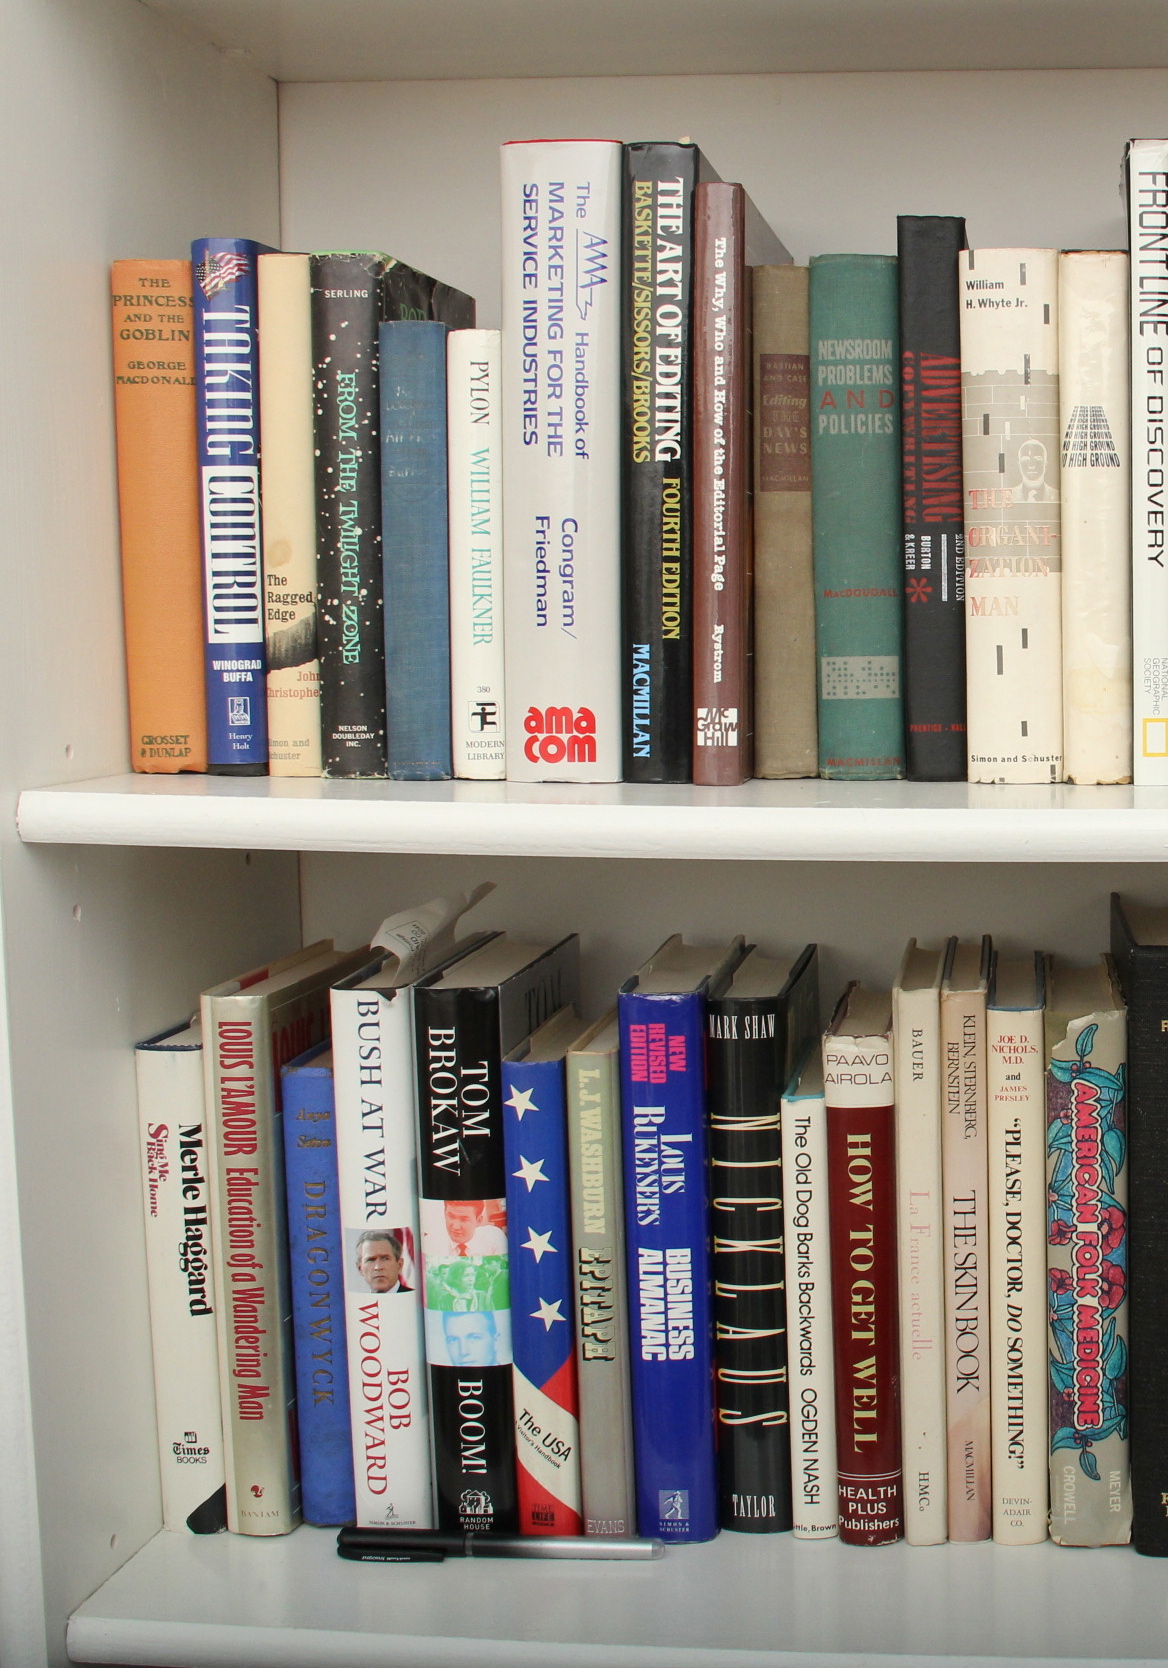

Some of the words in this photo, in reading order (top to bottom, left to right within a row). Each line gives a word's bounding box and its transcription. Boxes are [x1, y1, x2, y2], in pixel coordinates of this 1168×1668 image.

[523, 183, 539, 289] SERVICE
[657, 177, 685, 236] THE
[657, 239, 682, 300] ART
[1138, 171, 1168, 336] FRONTLINE
[139, 278, 171, 289] THE
[325, 290, 368, 298] SERLING
[966, 280, 1004, 290] William
[966, 299, 976, 309] H.
[978, 298, 1012, 309] Whyte
[1015, 298, 1028, 308] Jr.
[120, 328, 191, 342] GOBLIN
[125, 314, 152, 324] AND
[158, 314, 185, 324] THE
[656, 304, 682, 350] OF
[523, 299, 539, 446] INDUSTRIES
[818, 340, 892, 358] NEWSROOM
[818, 365, 892, 385] PROBLEMS
[1147, 348, 1163, 385] OF
[338, 371, 357, 441] FROM
[470, 361, 488, 425] PYLON
[655, 356, 682, 462] EDITING
[818, 414, 893, 434] POLICIES
[338, 447, 357, 493] THE
[470, 447, 493, 535] WILLIAM
[1146, 395, 1164, 568] DISCOVERY
[338, 495, 360, 596] TWILIGHT
[536, 516, 550, 628] Friedman
[267, 575, 287, 586] The
[267, 591, 313, 606] Ragged
[471, 548, 493, 646] FAULKNER
[560, 517, 578, 639] Congram/
[267, 609, 295, 622] Edge
[343, 604, 360, 664] ZONE
[213, 661, 262, 671] WINOGRAD
[223, 673, 253, 682] BUFFA
[713, 625, 724, 683] Rystrom
[218, 1022, 254, 1070] LOUIS
[357, 999, 382, 1088] BUSH
[710, 1014, 738, 1039] MARK
[745, 1014, 776, 1038] SHAW
[912, 1028, 923, 1081] BAUER
[824, 1072, 892, 1084] AIROLA
[827, 1054, 888, 1066] PAAVO
[220, 1076, 257, 1156] L'AMOUR
[360, 1098, 384, 1138] AT
[429, 1026, 461, 1176] BROKAW
[461, 1061, 490, 1138] TOM
[178, 1123, 206, 1200] Merle
[362, 1146, 387, 1222] WAR
[633, 1106, 666, 1226] RUKEYSER'S
[660, 1132, 692, 1194] LOUIS
[847, 1133, 873, 1211] HOW
[177, 1206, 213, 1317] Haggard
[849, 1224, 874, 1272] TO
[639, 1248, 667, 1361] ALMANAC
[665, 1248, 694, 1360] BUSINESS
[850, 1280, 876, 1346] GET
[358, 1301, 387, 1495] WOODWARD
[387, 1368, 410, 1429] BOB
[458, 1379, 487, 1474] BOOM!
[801, 1388, 819, 1452] OGDEN
[852, 1355, 878, 1453] WELL
[173, 1442, 209, 1456] Times
[732, 1494, 776, 1517] TAYLOR
[803, 1459, 820, 1505] NASH
[839, 1485, 896, 1499] HEALTH
[849, 1501, 886, 1514] PLUS
[839, 1515, 899, 1530] Publishers
